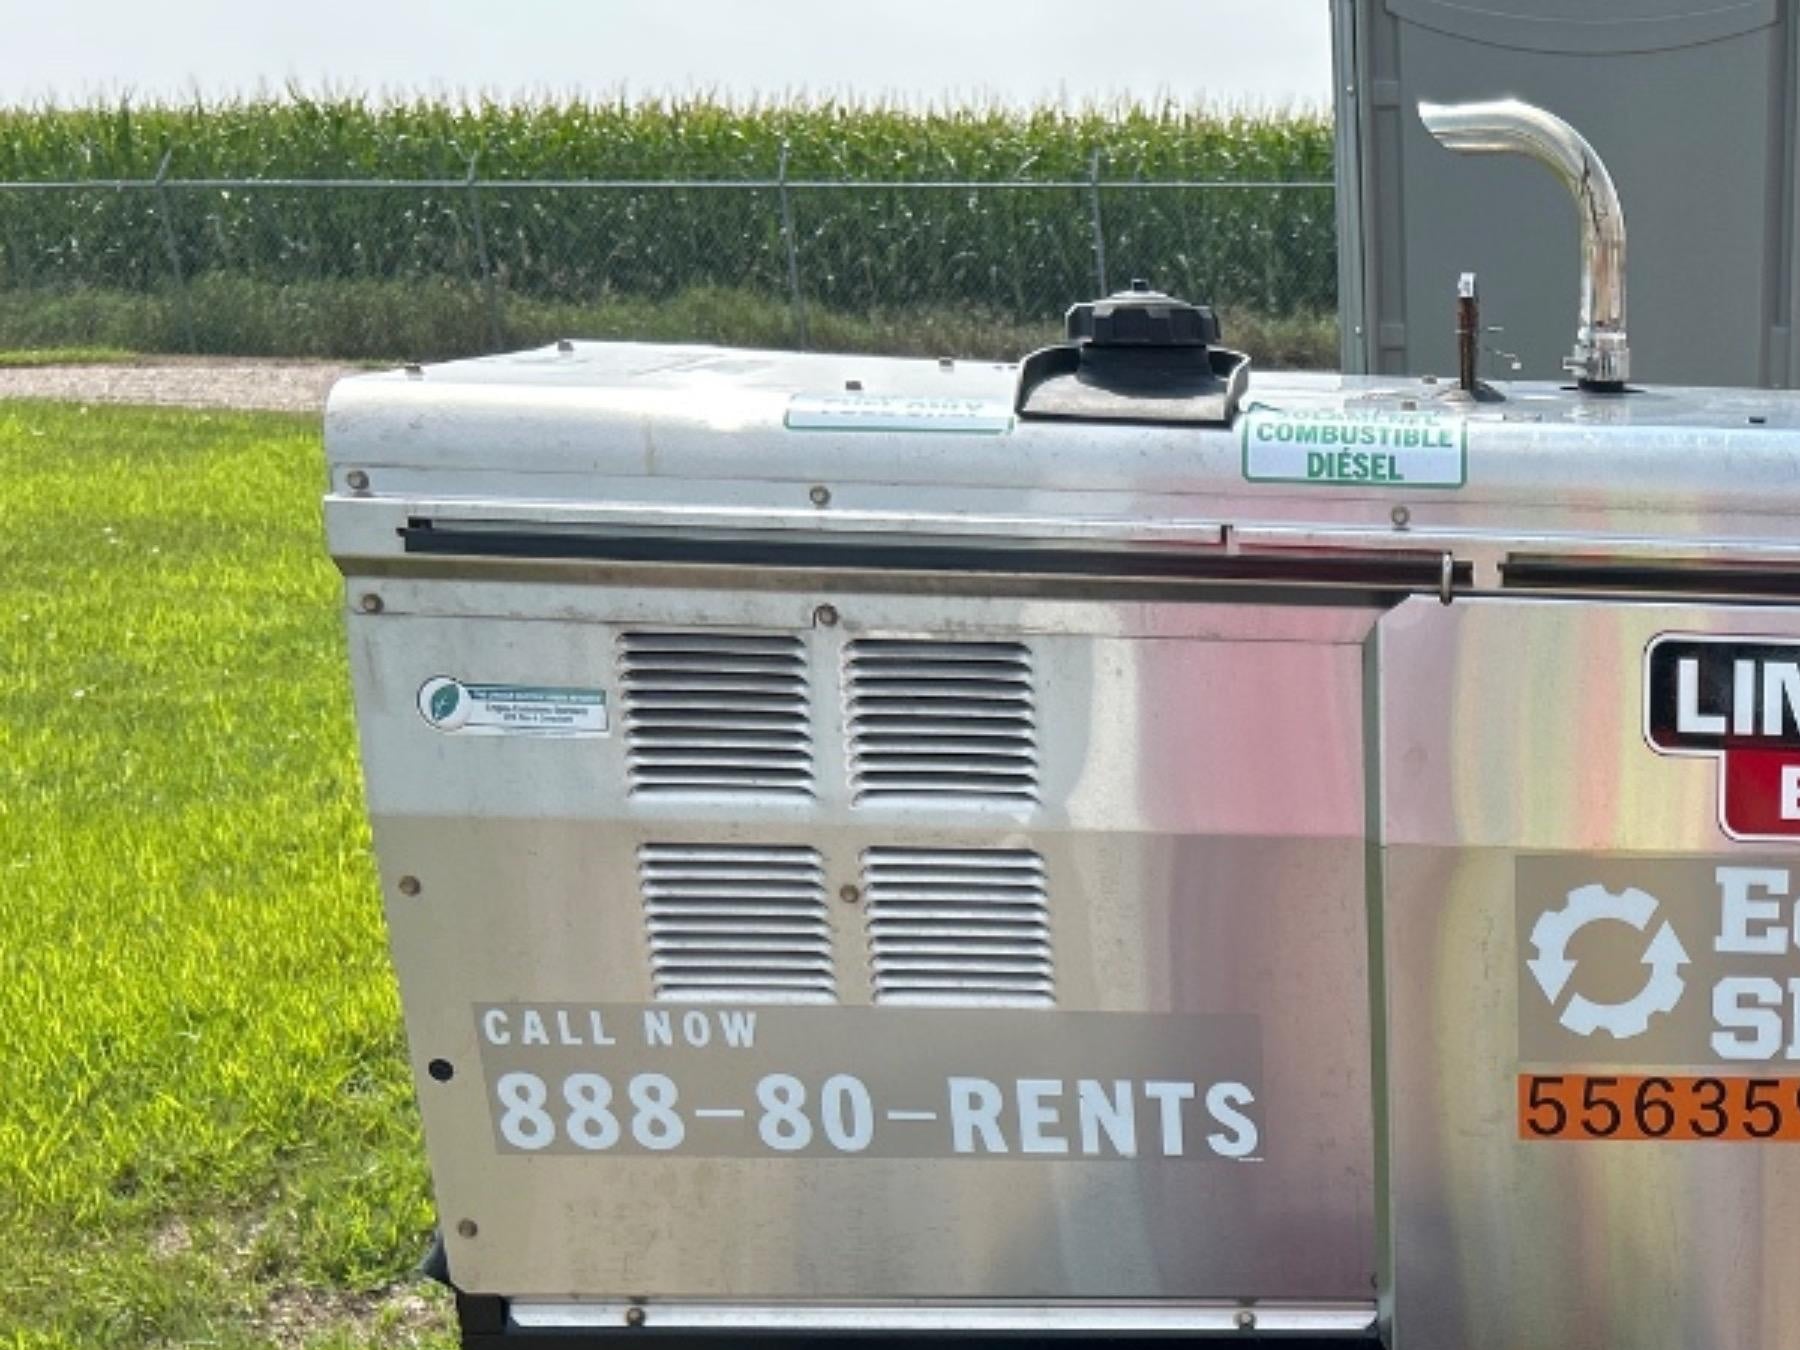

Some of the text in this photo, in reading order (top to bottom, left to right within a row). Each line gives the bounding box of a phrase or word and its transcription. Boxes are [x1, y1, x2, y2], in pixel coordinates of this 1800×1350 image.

[1256, 422, 1453, 449] COMBUSTIBLE
[1306, 447, 1405, 481] DIÉSEL
[483, 1009, 757, 1049] CALL NOW
[496, 1071, 1259, 1159] 888-80-RENTS
